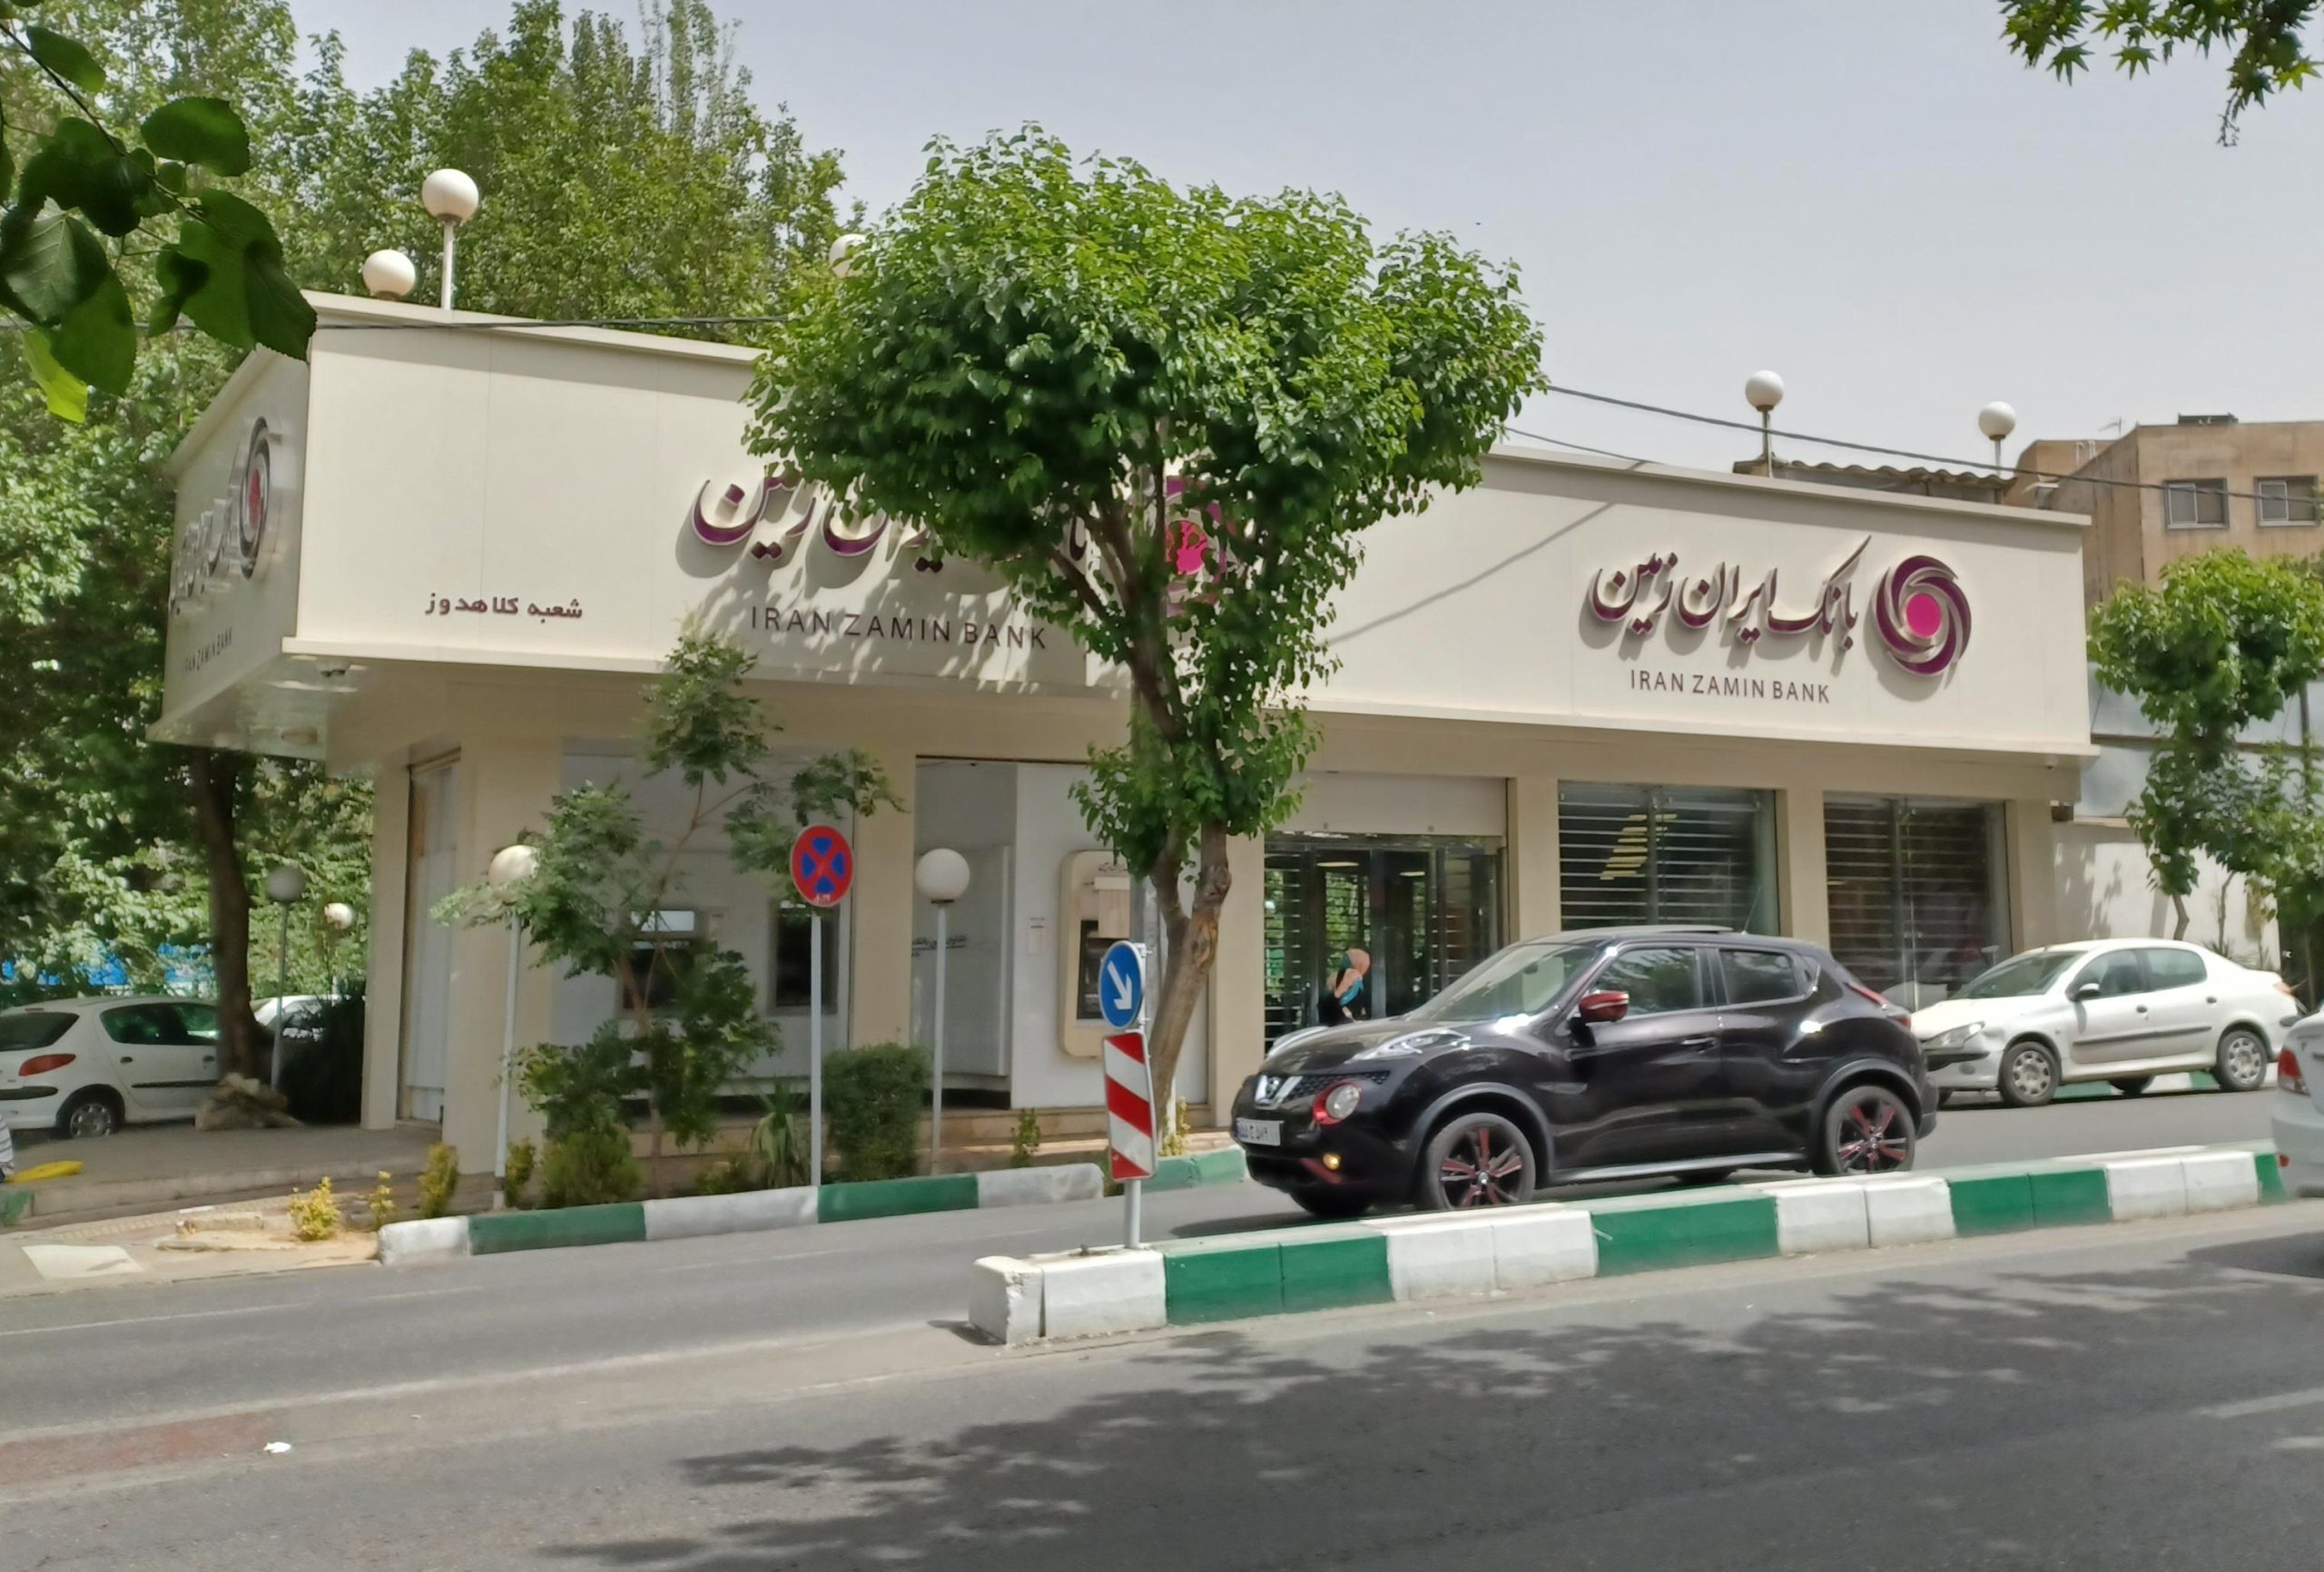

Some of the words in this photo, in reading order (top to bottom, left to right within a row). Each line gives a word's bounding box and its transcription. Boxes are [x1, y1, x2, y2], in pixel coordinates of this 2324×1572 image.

[425, 592, 519, 615] کلاهدوز
[527, 598, 583, 624] شعبه
[1592, 552, 1679, 634] زمین
[1679, 561, 1777, 643] ایران
[1767, 535, 1872, 651] بانک
[751, 605, 831, 633] IRAN
[843, 614, 950, 642] ZAMIN
[963, 622, 1047, 649] BANK
[1630, 670, 1684, 693] IRAN
[1691, 674, 1765, 698] ZAMIN
[1772, 681, 1830, 703] BANK
